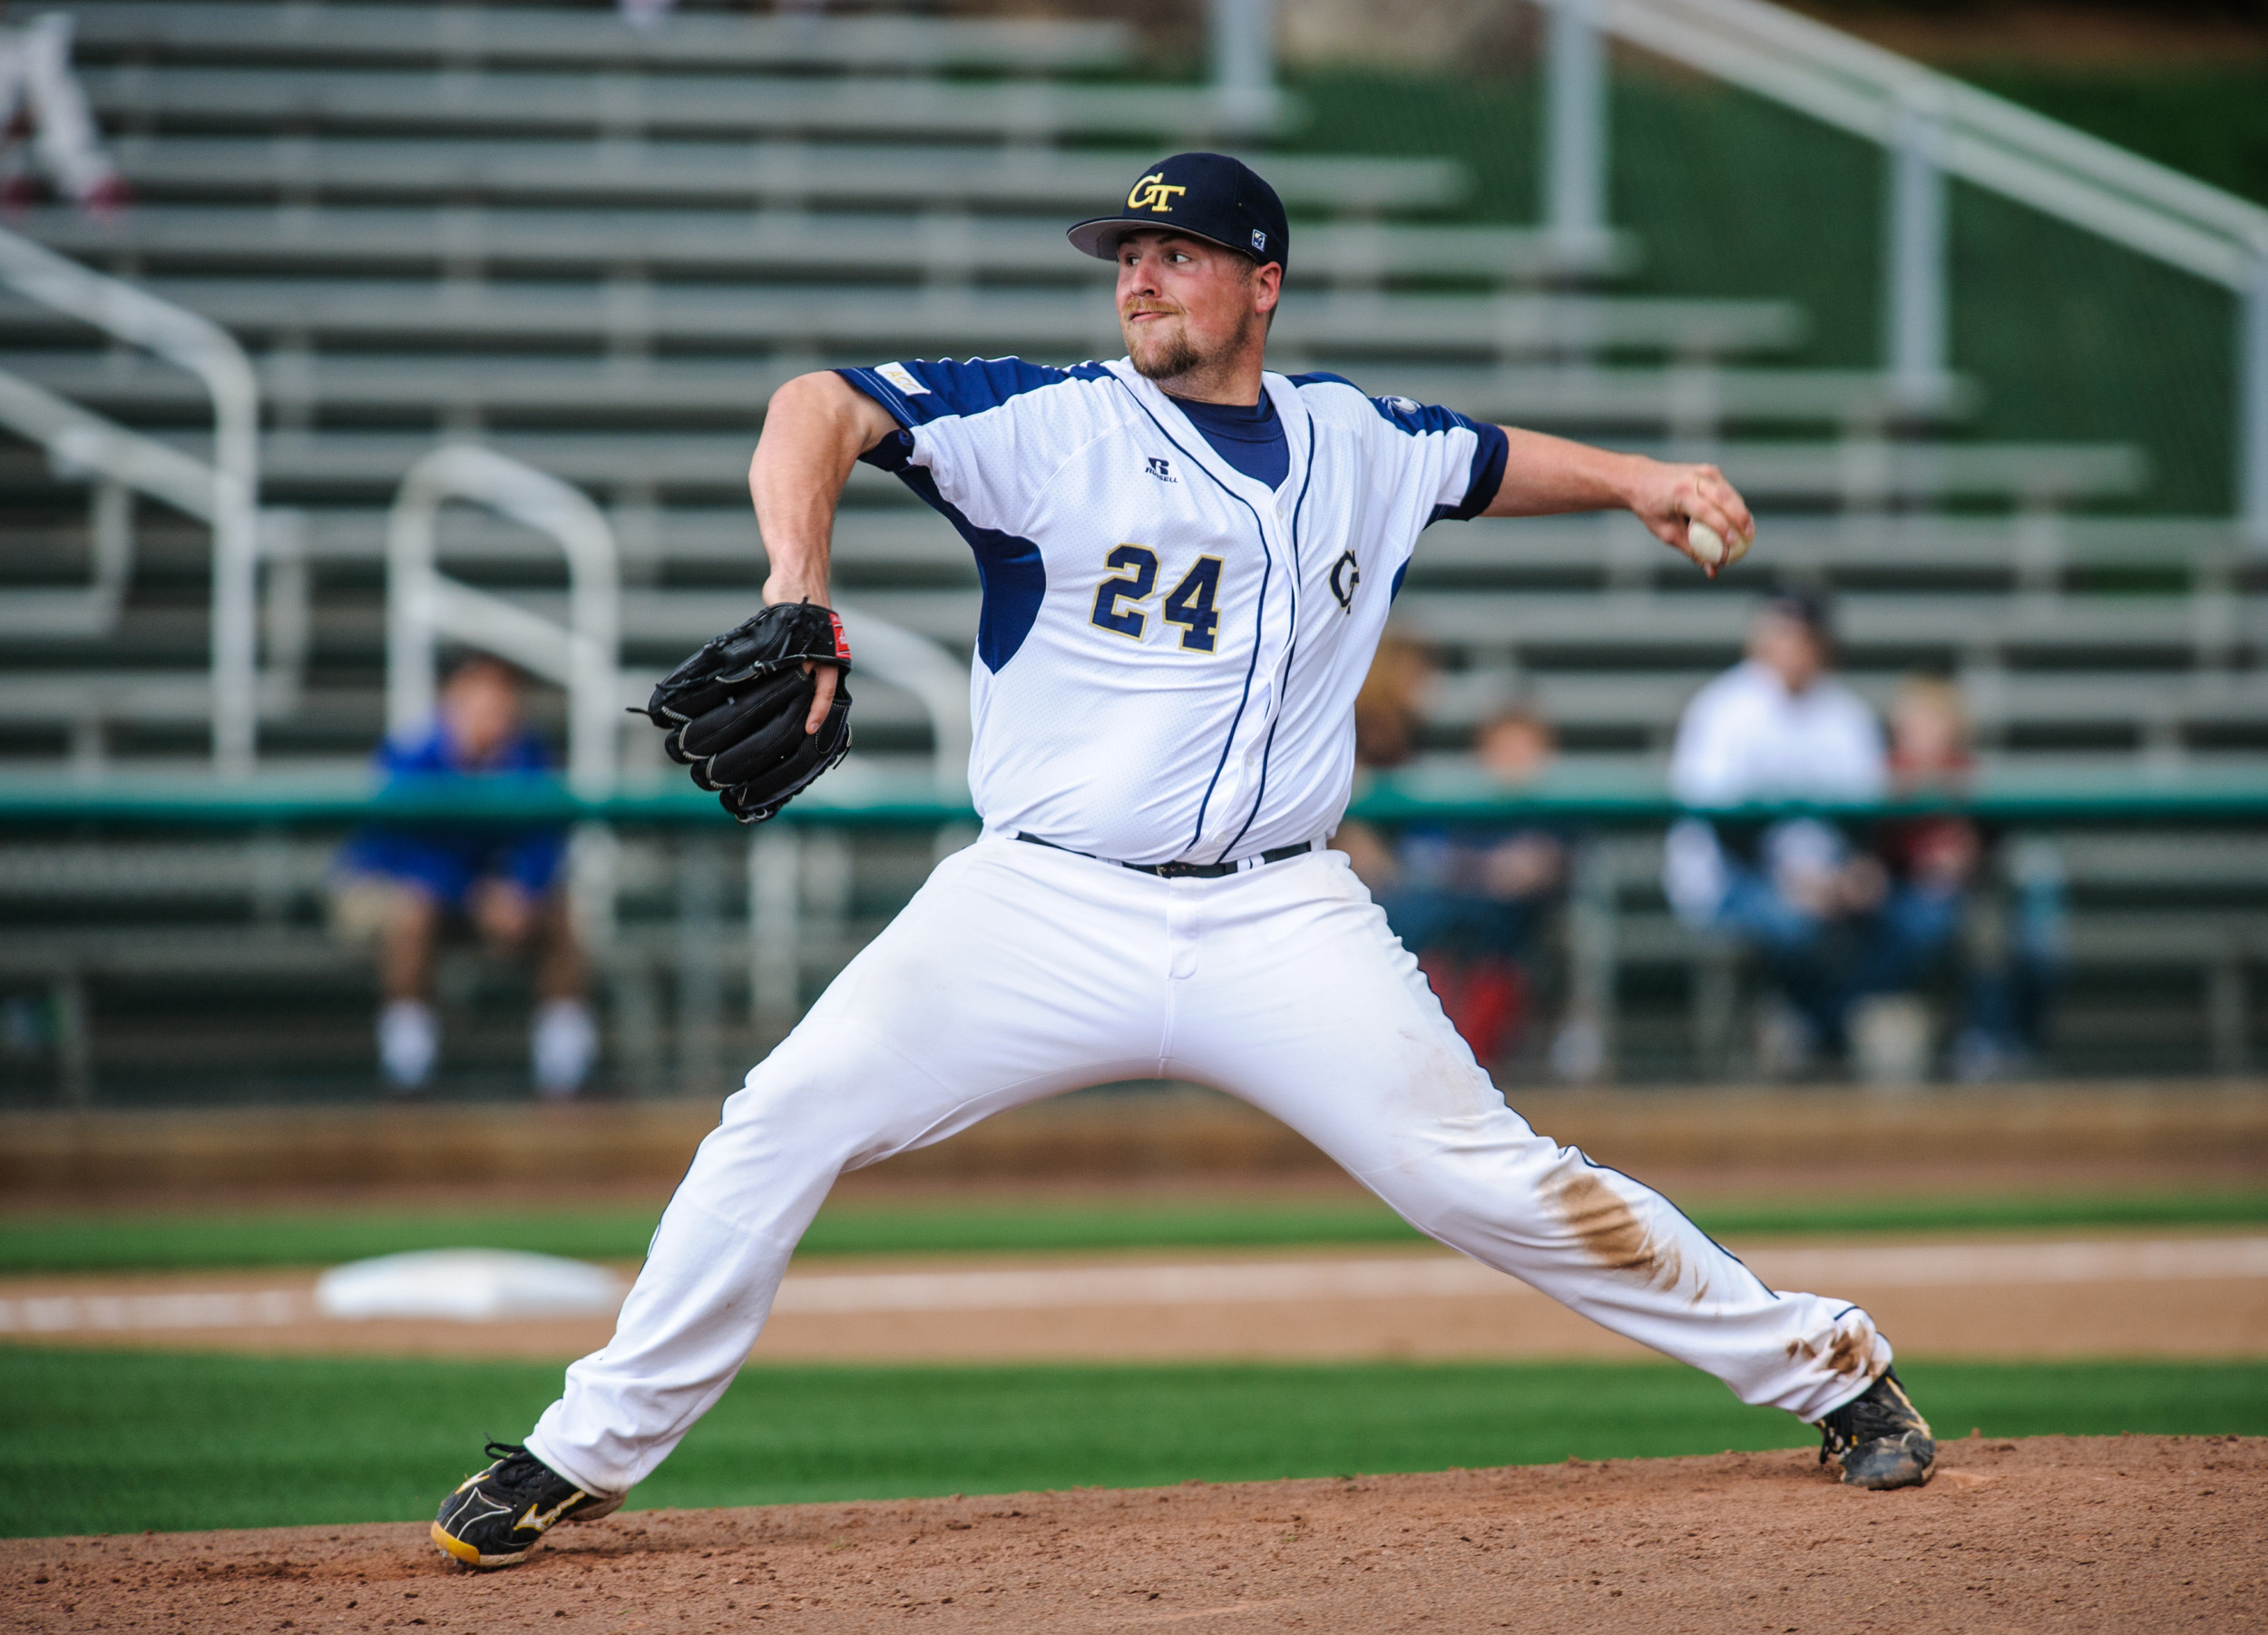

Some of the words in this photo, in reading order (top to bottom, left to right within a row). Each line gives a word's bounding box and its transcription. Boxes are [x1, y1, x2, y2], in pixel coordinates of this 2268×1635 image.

[1128, 172, 1186, 211] GT
[885, 370, 921, 391] ACC
[1089, 543, 1225, 655] 24
